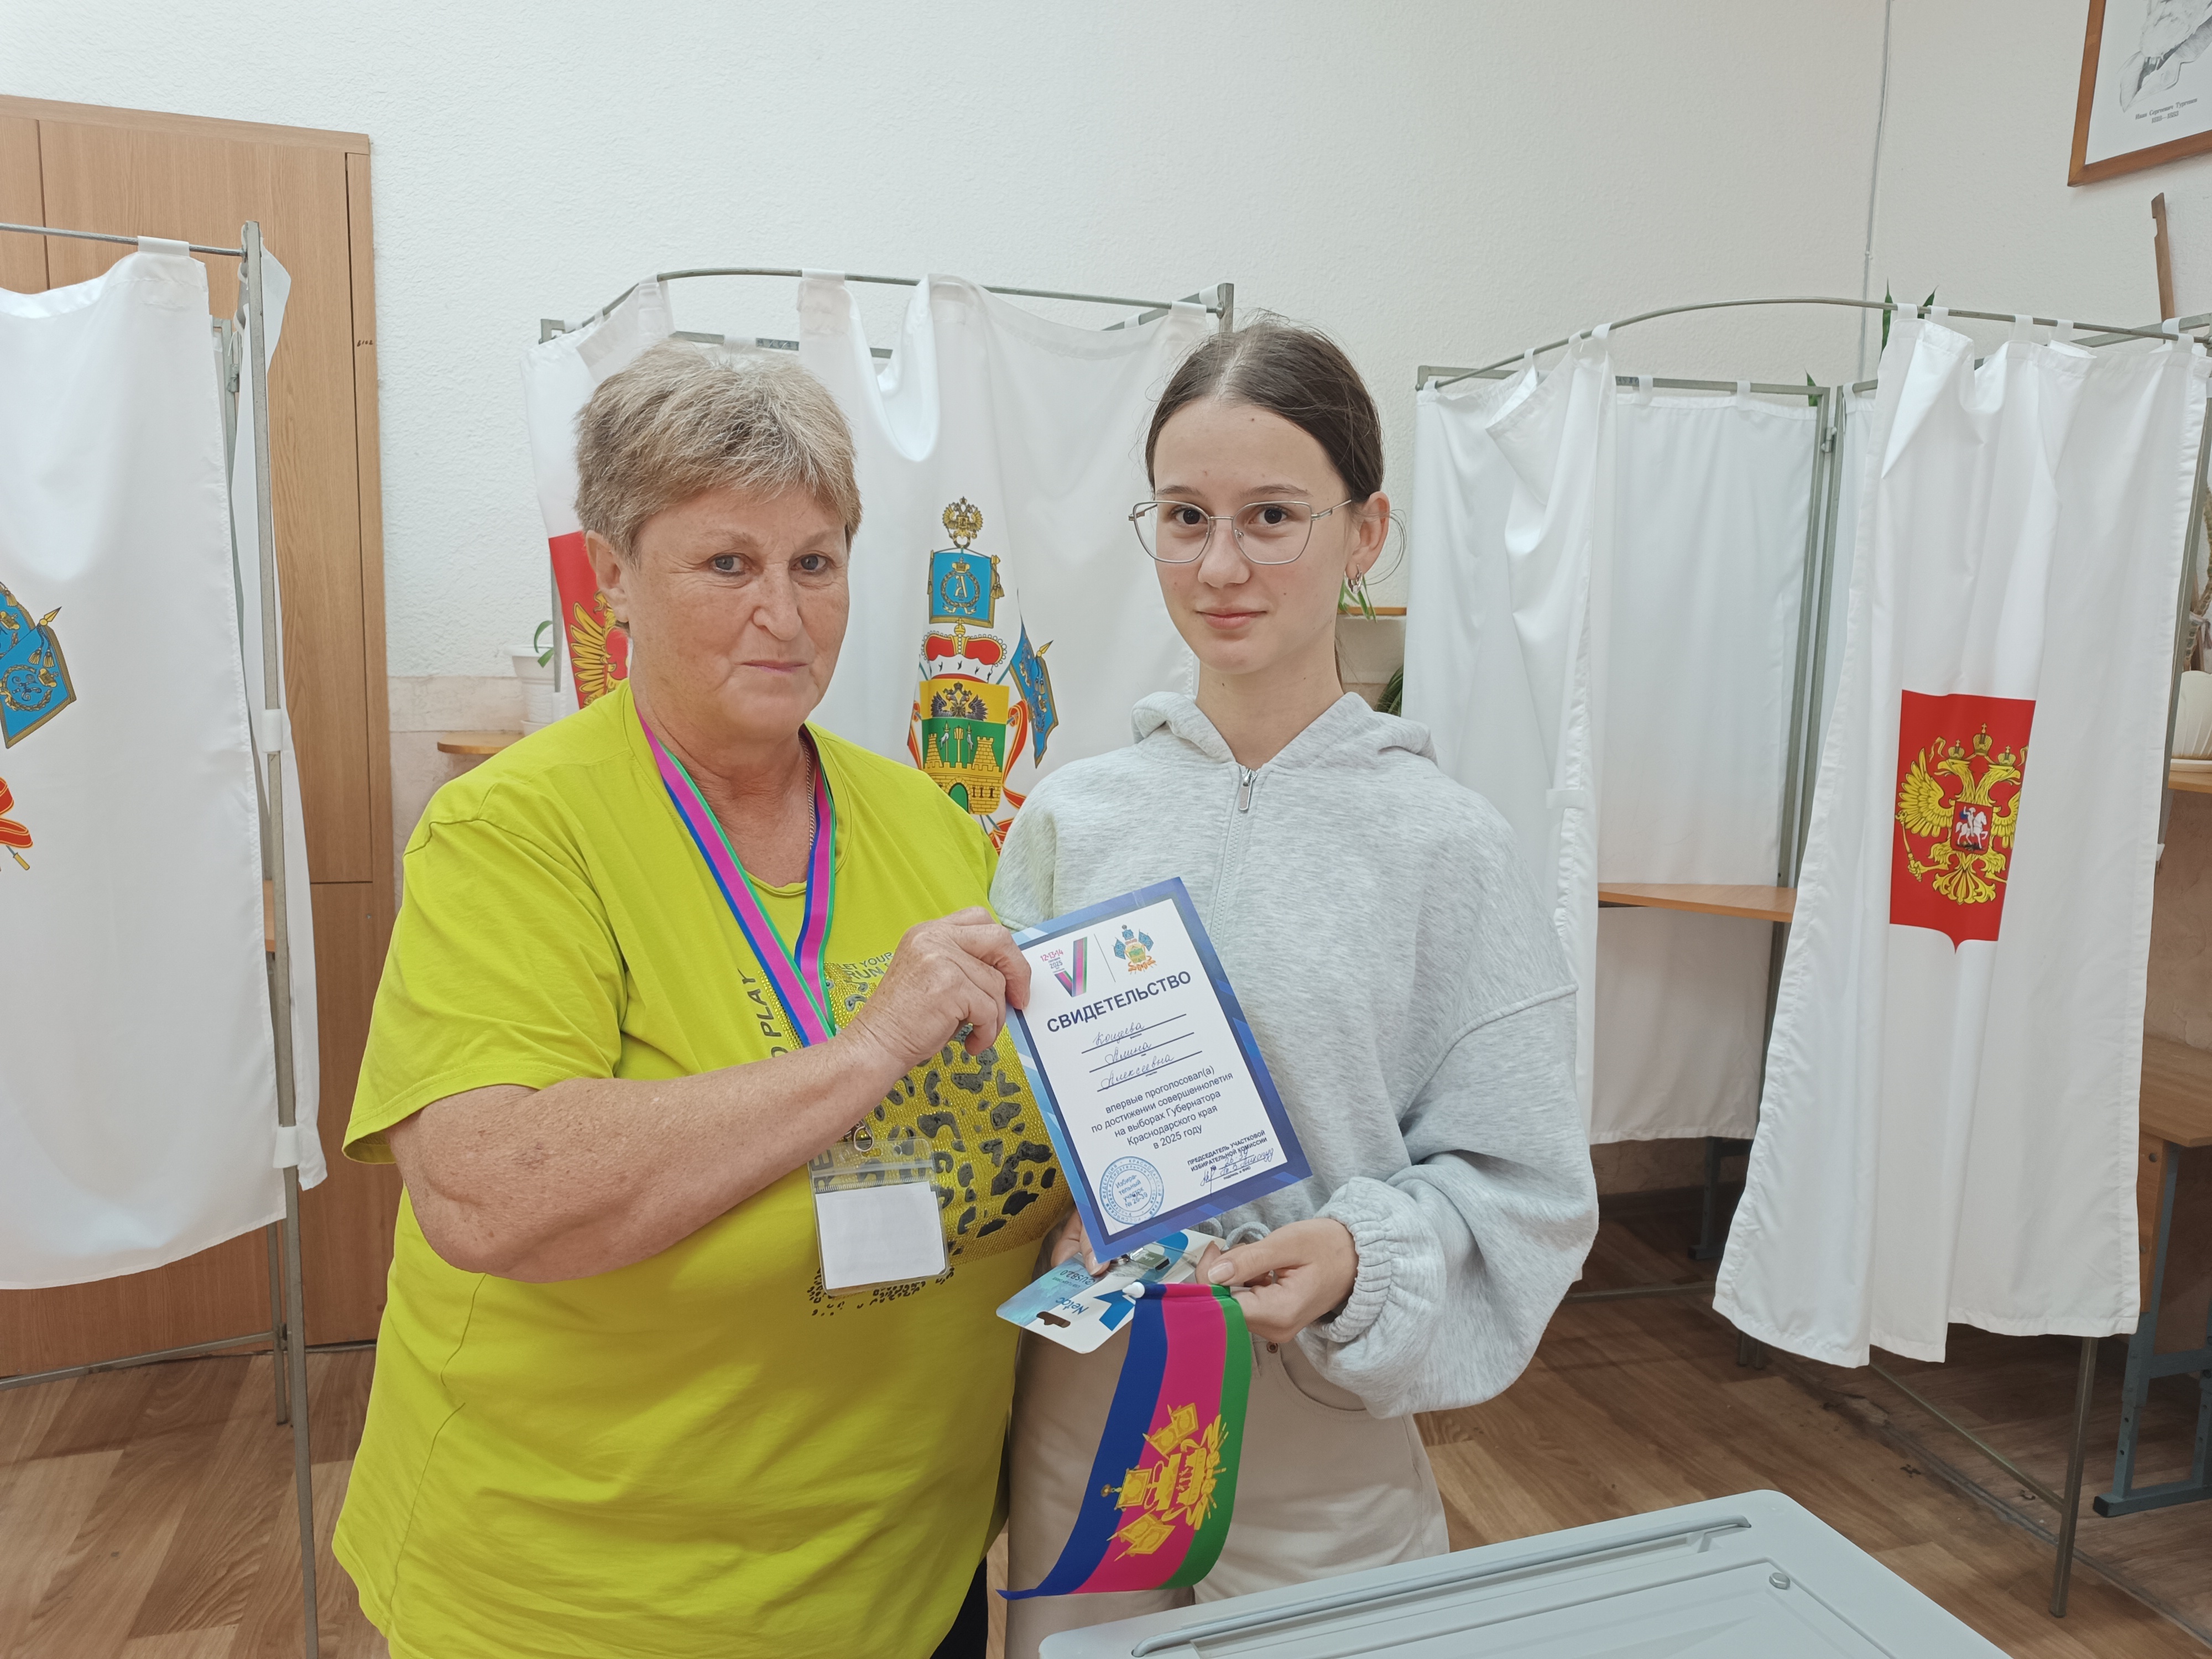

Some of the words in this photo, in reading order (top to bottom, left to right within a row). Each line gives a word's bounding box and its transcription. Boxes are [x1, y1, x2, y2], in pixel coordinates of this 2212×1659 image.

[859, 952, 893, 968] YOUR
[1050, 960, 1063, 969] 2025
[843, 966, 885, 979] RUN
[737, 968, 782, 1037] PLAY
[1047, 971, 1191, 1032] СВИДЕТЕЛЬСТВО
[1104, 1041, 1152, 1065] Алина
[1100, 1053, 1175, 1090] Алексеевна
[1105, 1094, 1144, 1114] впервые
[1145, 1065, 1215, 1102] проголосовал(а)
[1091, 1123, 1103, 1133] по
[1105, 1102, 1157, 1129] достижении
[1157, 1072, 1234, 1107] совершеннолетия
[1114, 1128, 1126, 1138] на
[1128, 1113, 1165, 1132] выборах
[1166, 1091, 1221, 1118] Губернатора
[1127, 1113, 1196, 1146] Краснодарского
[1197, 1105, 1218, 1119] края
[1160, 1131, 1182, 1146] 2025
[1183, 1125, 1202, 1138] году
[1187, 1146, 1229, 1165] ПРЕДСЕДАТЕЛЬ
[1230, 1130, 1265, 1149] УЧАСТКОВОЙ
[1191, 1149, 1237, 1172] ИЗБИРАТЕЛЬНОЙ
[1237, 1137, 1267, 1154] КОМИССИИ
[1115, 1175, 1137, 1188] Избира-
[1119, 1180, 1141, 1195] тельный
[1123, 1187, 1144, 1202] участок
[1149, 1201, 1159, 1215] КРАЙ
[1055, 1297, 1089, 1315] Netac
